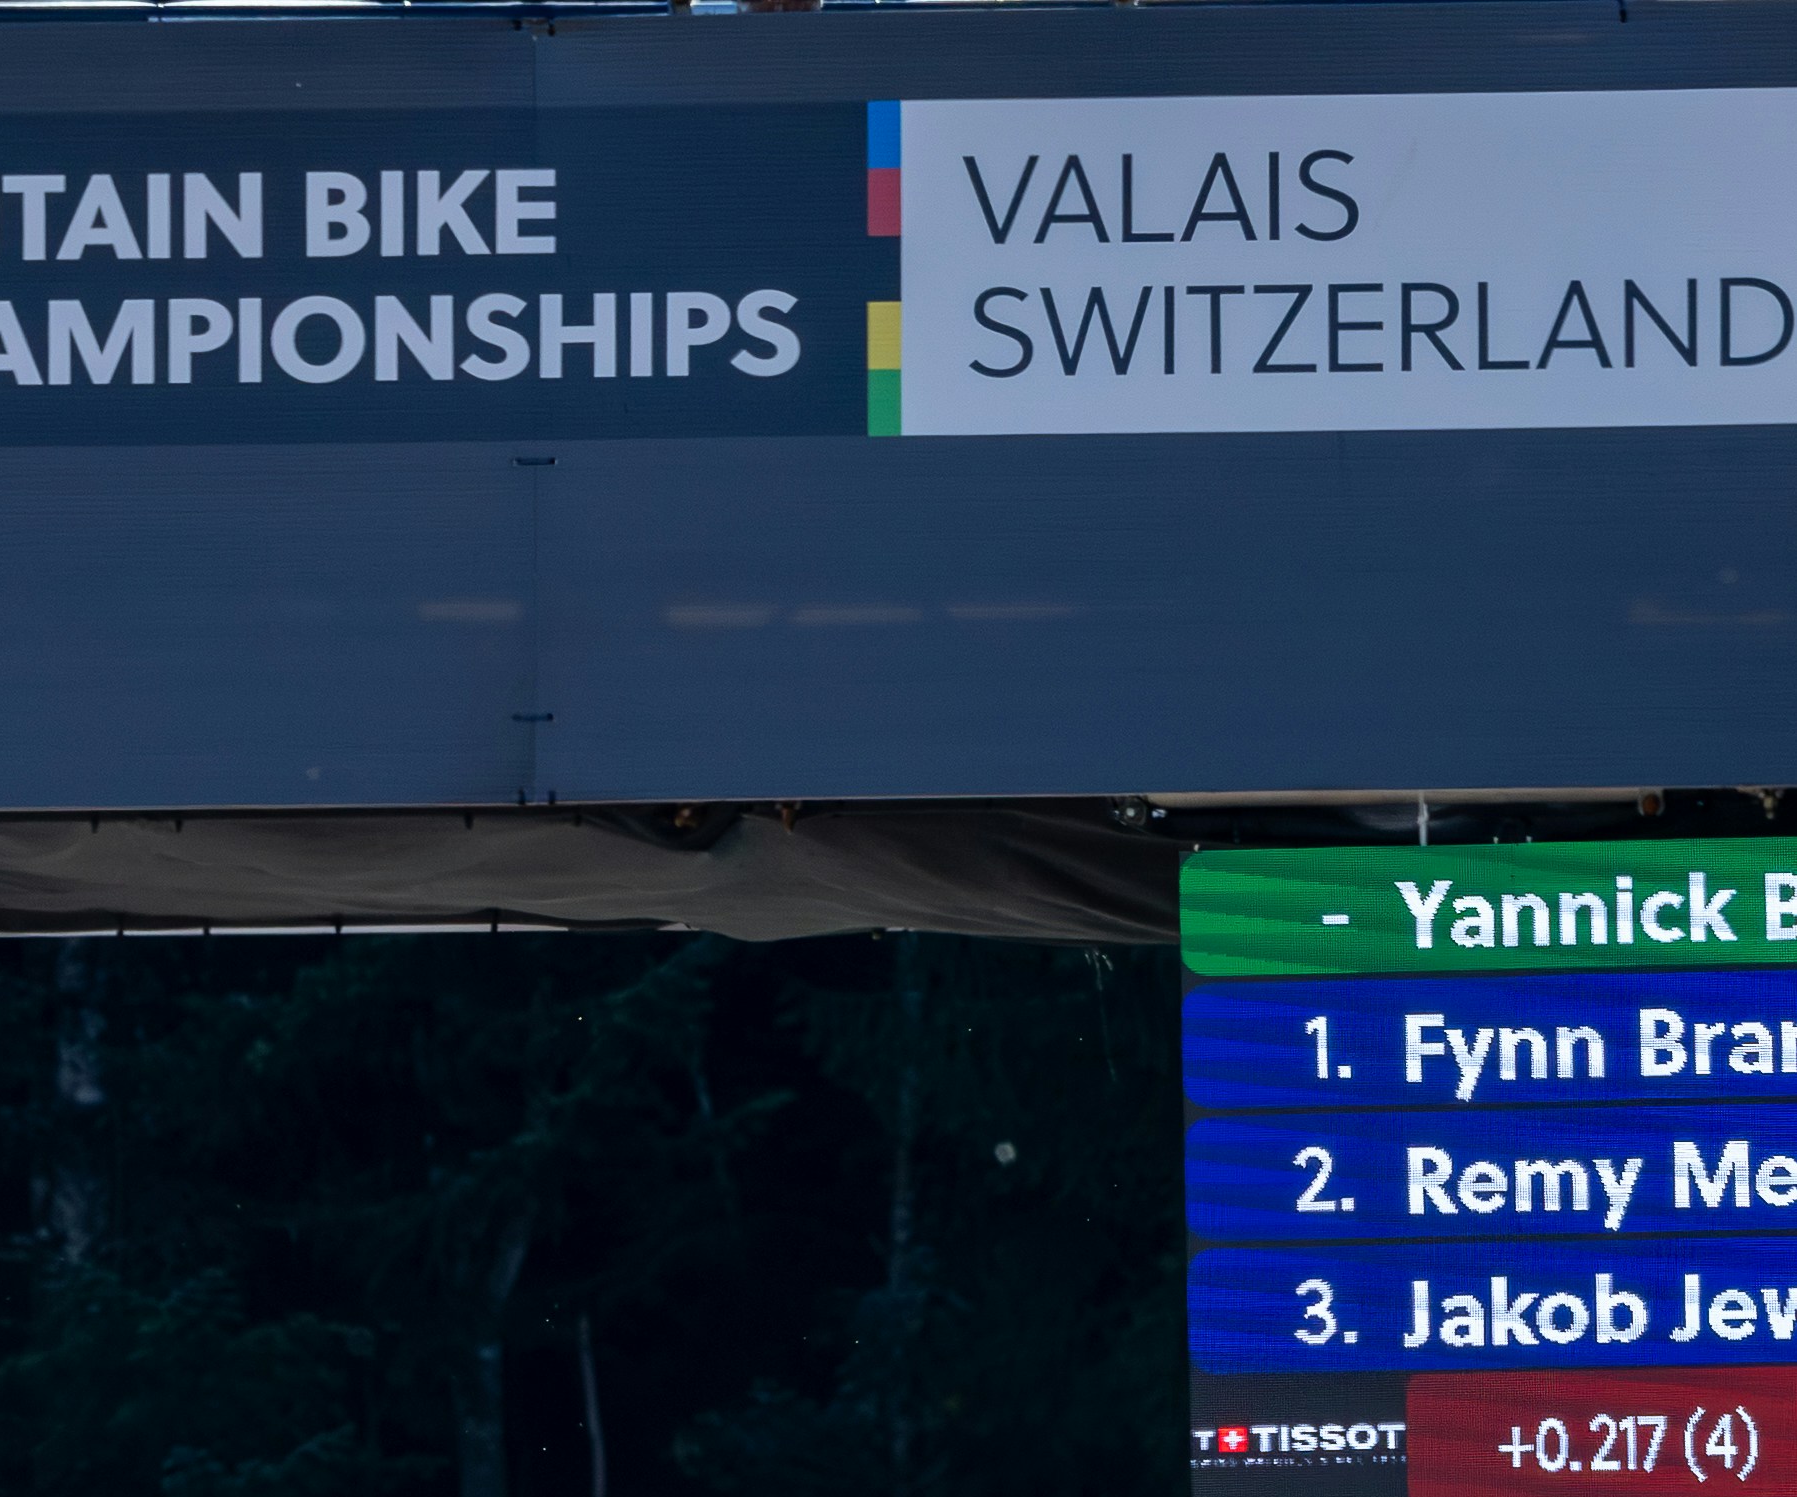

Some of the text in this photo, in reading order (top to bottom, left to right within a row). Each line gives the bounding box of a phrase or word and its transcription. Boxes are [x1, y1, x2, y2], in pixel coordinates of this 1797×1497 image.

[305, 168, 558, 258] BIKE
[962, 149, 1361, 245] VALAIS
[969, 276, 1795, 379] SWITZERLAND
[1394, 872, 1738, 949] Yannick
[1305, 1016, 1352, 1079] 1.
[1404, 1012, 1605, 1102] Fynn
[1292, 1140, 1797, 1232] 2. Remy Me
[1294, 1278, 1359, 1345] 3.
[1403, 1273, 1649, 1348] Jakob
[1249, 1422, 1406, 1454] TISSOT
[1498, 1404, 1760, 1484] +0.217 (4)
